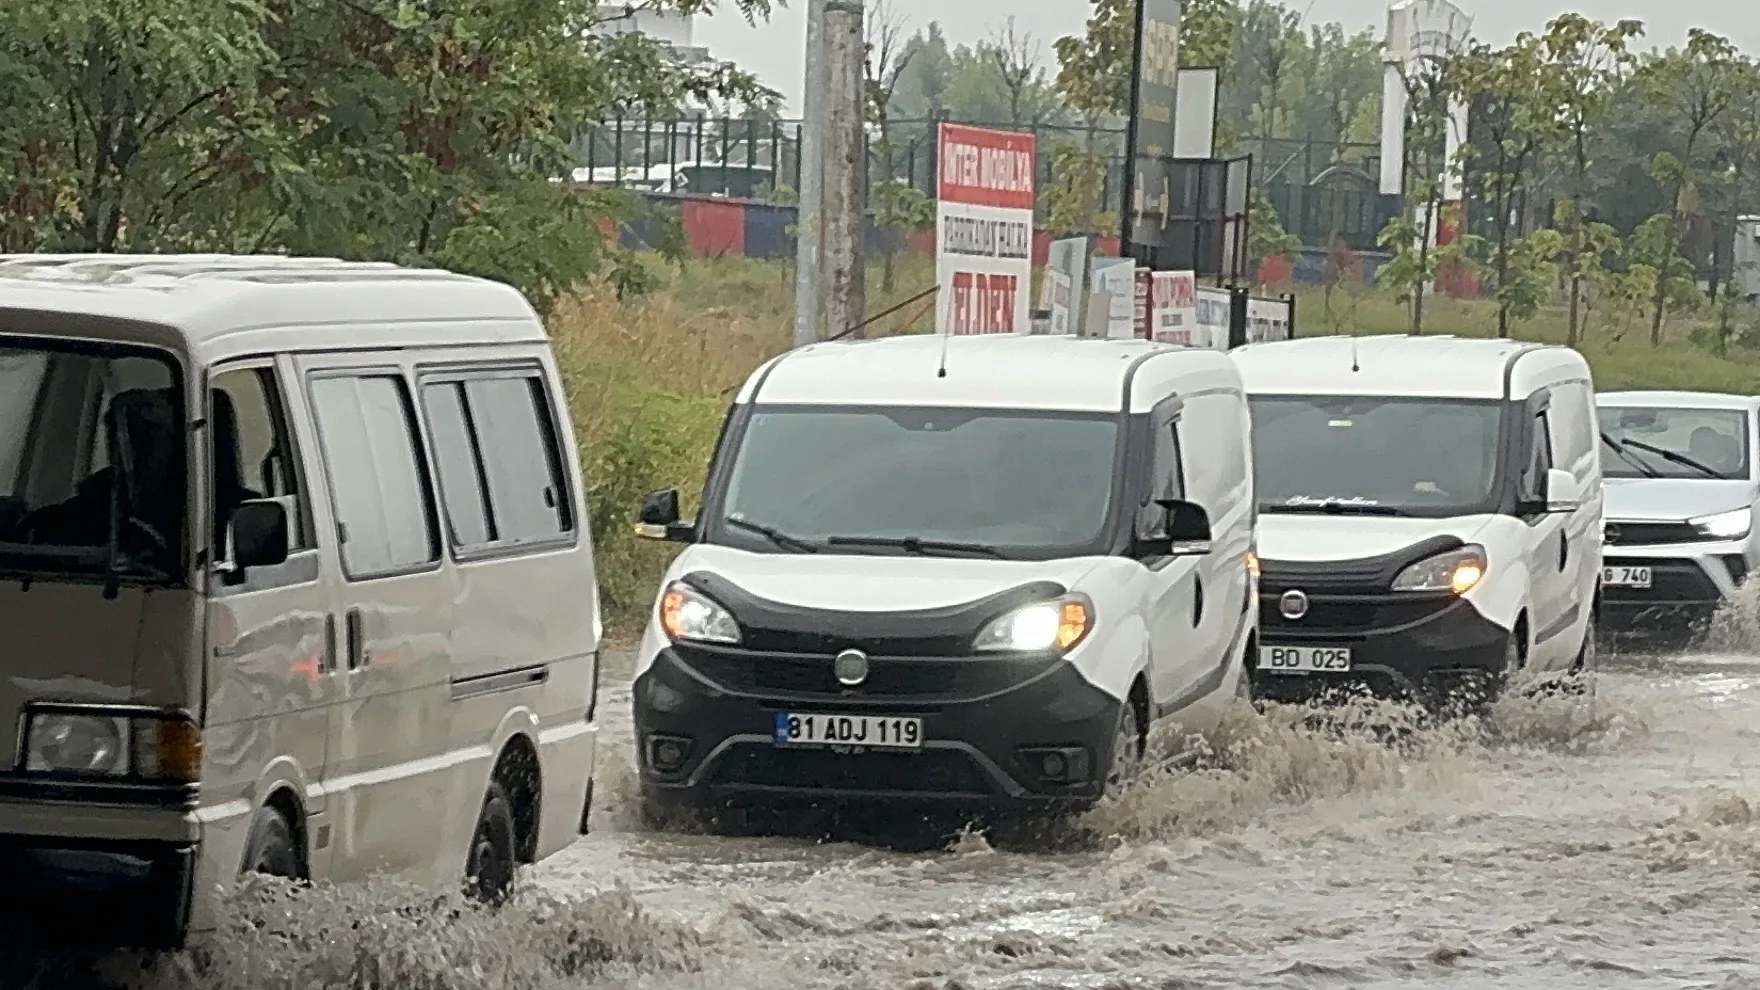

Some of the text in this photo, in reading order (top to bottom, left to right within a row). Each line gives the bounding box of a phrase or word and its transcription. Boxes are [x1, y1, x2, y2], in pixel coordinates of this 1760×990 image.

[1621, 568, 1648, 582] 740
[1271, 648, 1300, 668] BD
[1311, 649, 1348, 669] 025
[787, 716, 814, 740] 81
[823, 717, 867, 742] ADJ
[877, 719, 918, 744] 119
